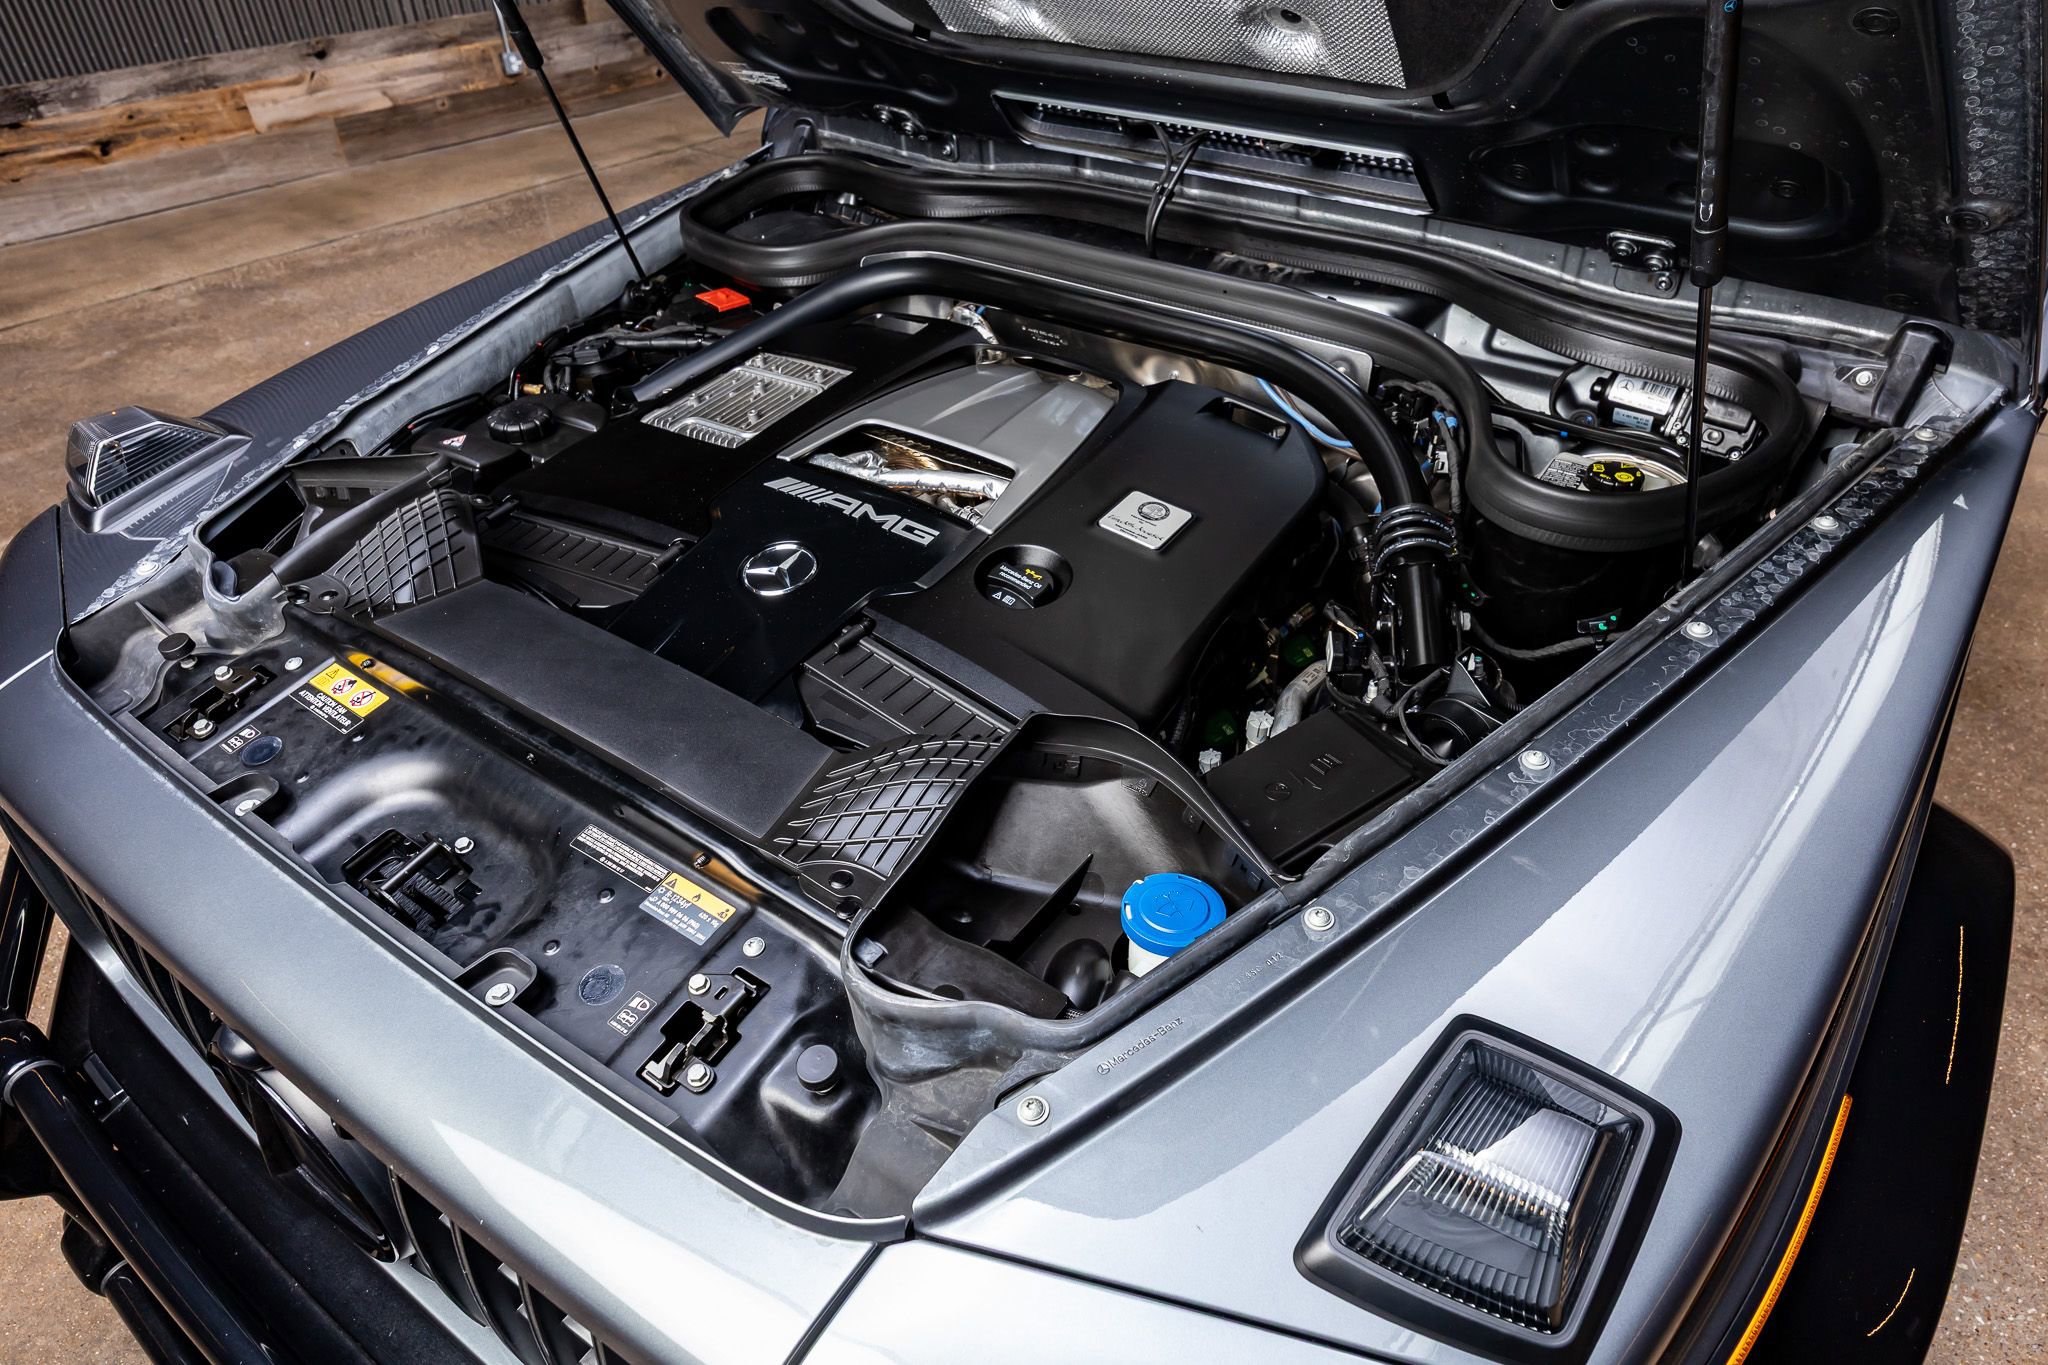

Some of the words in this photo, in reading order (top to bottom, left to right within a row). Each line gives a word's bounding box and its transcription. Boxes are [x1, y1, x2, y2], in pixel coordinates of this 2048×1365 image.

[811, 492, 940, 547] AMG
[999, 571, 1033, 590] recommended
[1000, 565, 1034, 585] Mercedes-Benz
[299, 689, 325, 708] ATTENTION
[322, 705, 352, 727] VENTILATEUR
[316, 692, 338, 708] CAUTION
[335, 704, 348, 715] FAN
[664, 890, 692, 909] R-1234yf
[1108, 1017, 1184, 1068] Mercedes-Benz
